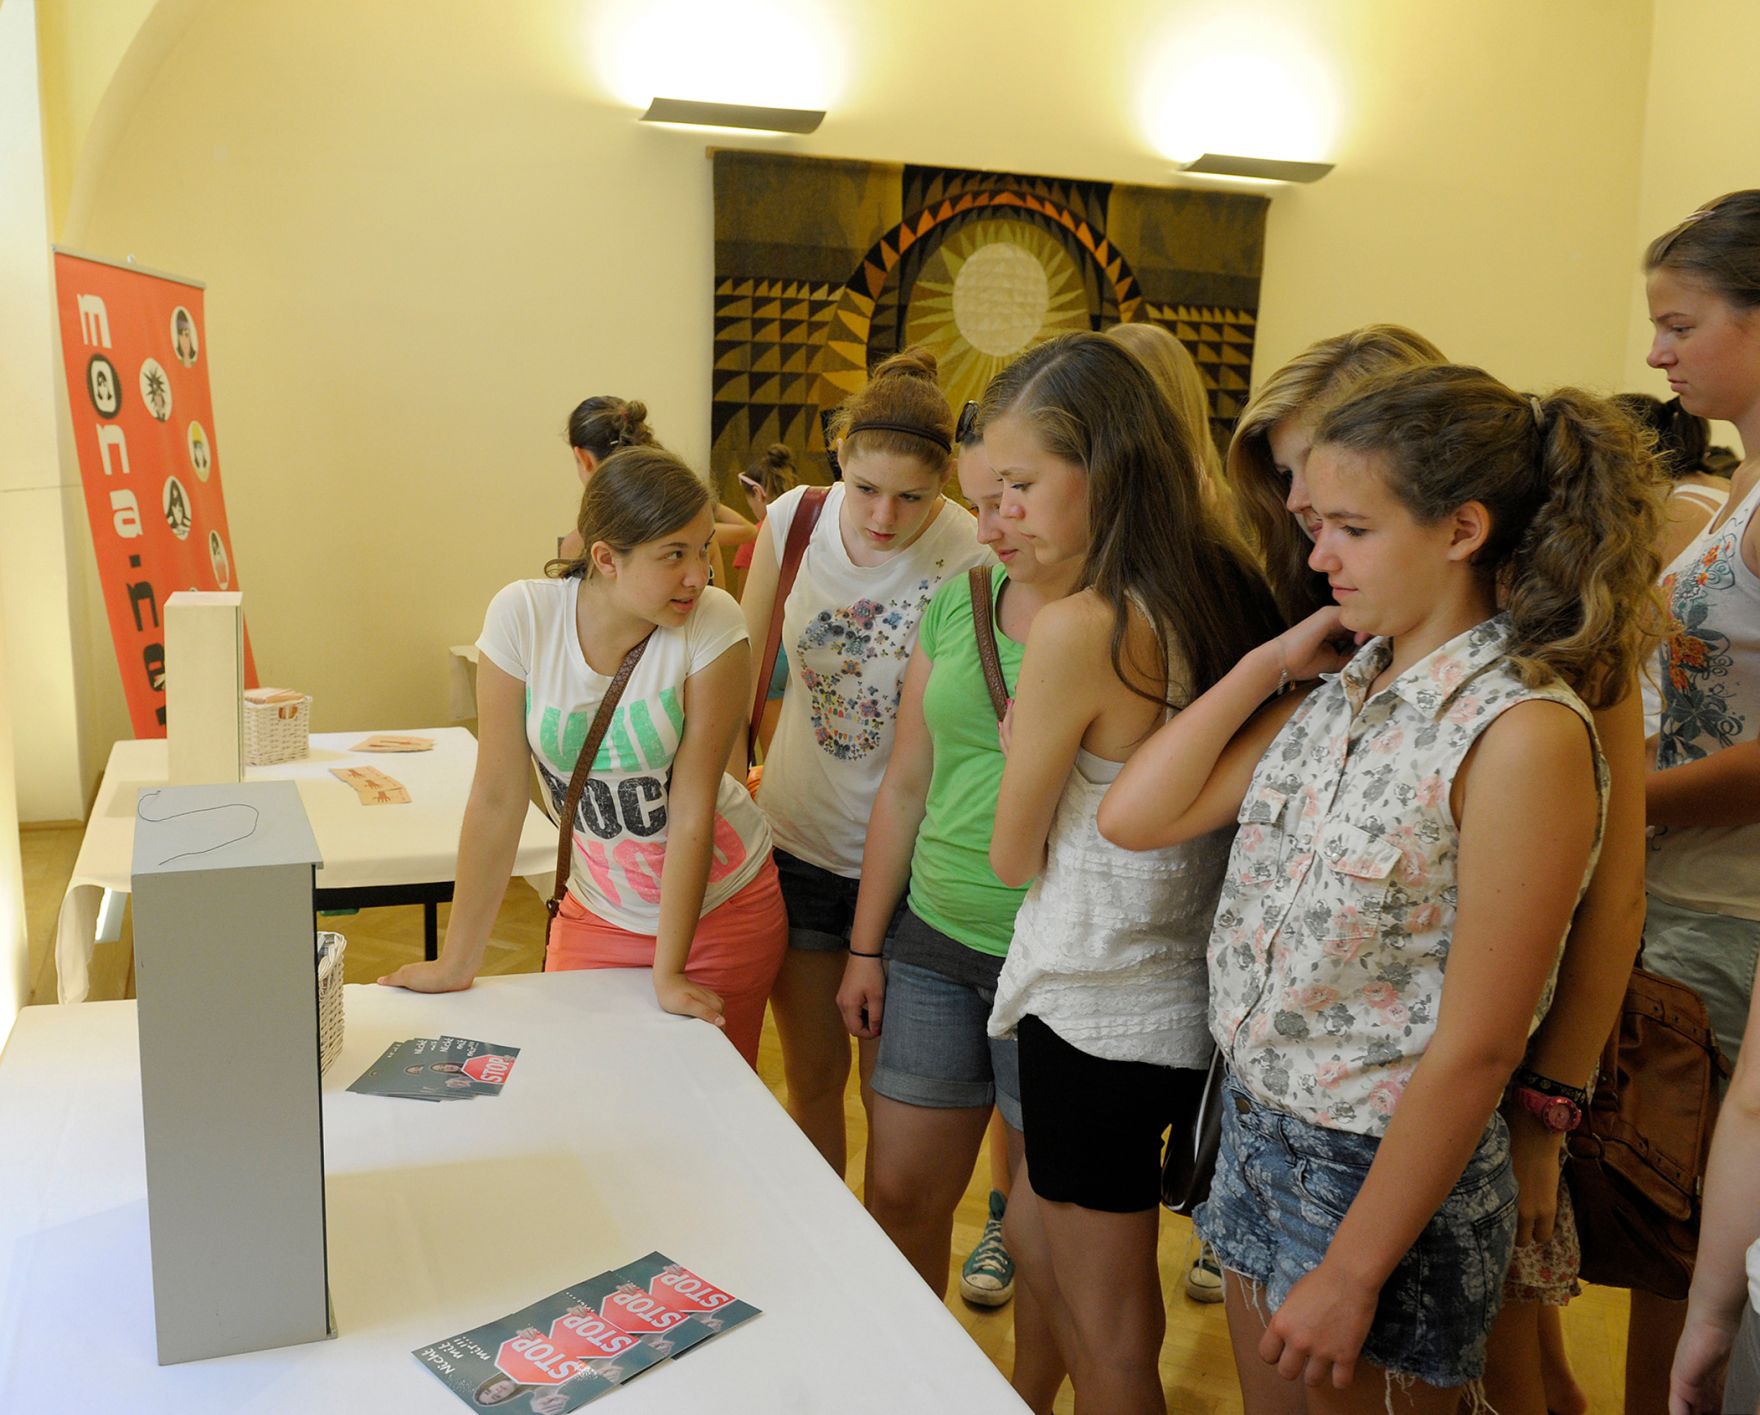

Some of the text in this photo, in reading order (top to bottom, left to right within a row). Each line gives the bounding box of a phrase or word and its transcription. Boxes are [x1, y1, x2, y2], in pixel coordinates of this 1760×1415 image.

[480, 1056, 510, 1083] STOP
[661, 1273, 729, 1308] STOP
[613, 1293, 682, 1328] STOP
[438, 1341, 465, 1360] mit
[562, 1315, 633, 1353] STOP
[421, 1347, 456, 1375] Nicht
[511, 1338, 580, 1379] STOP
